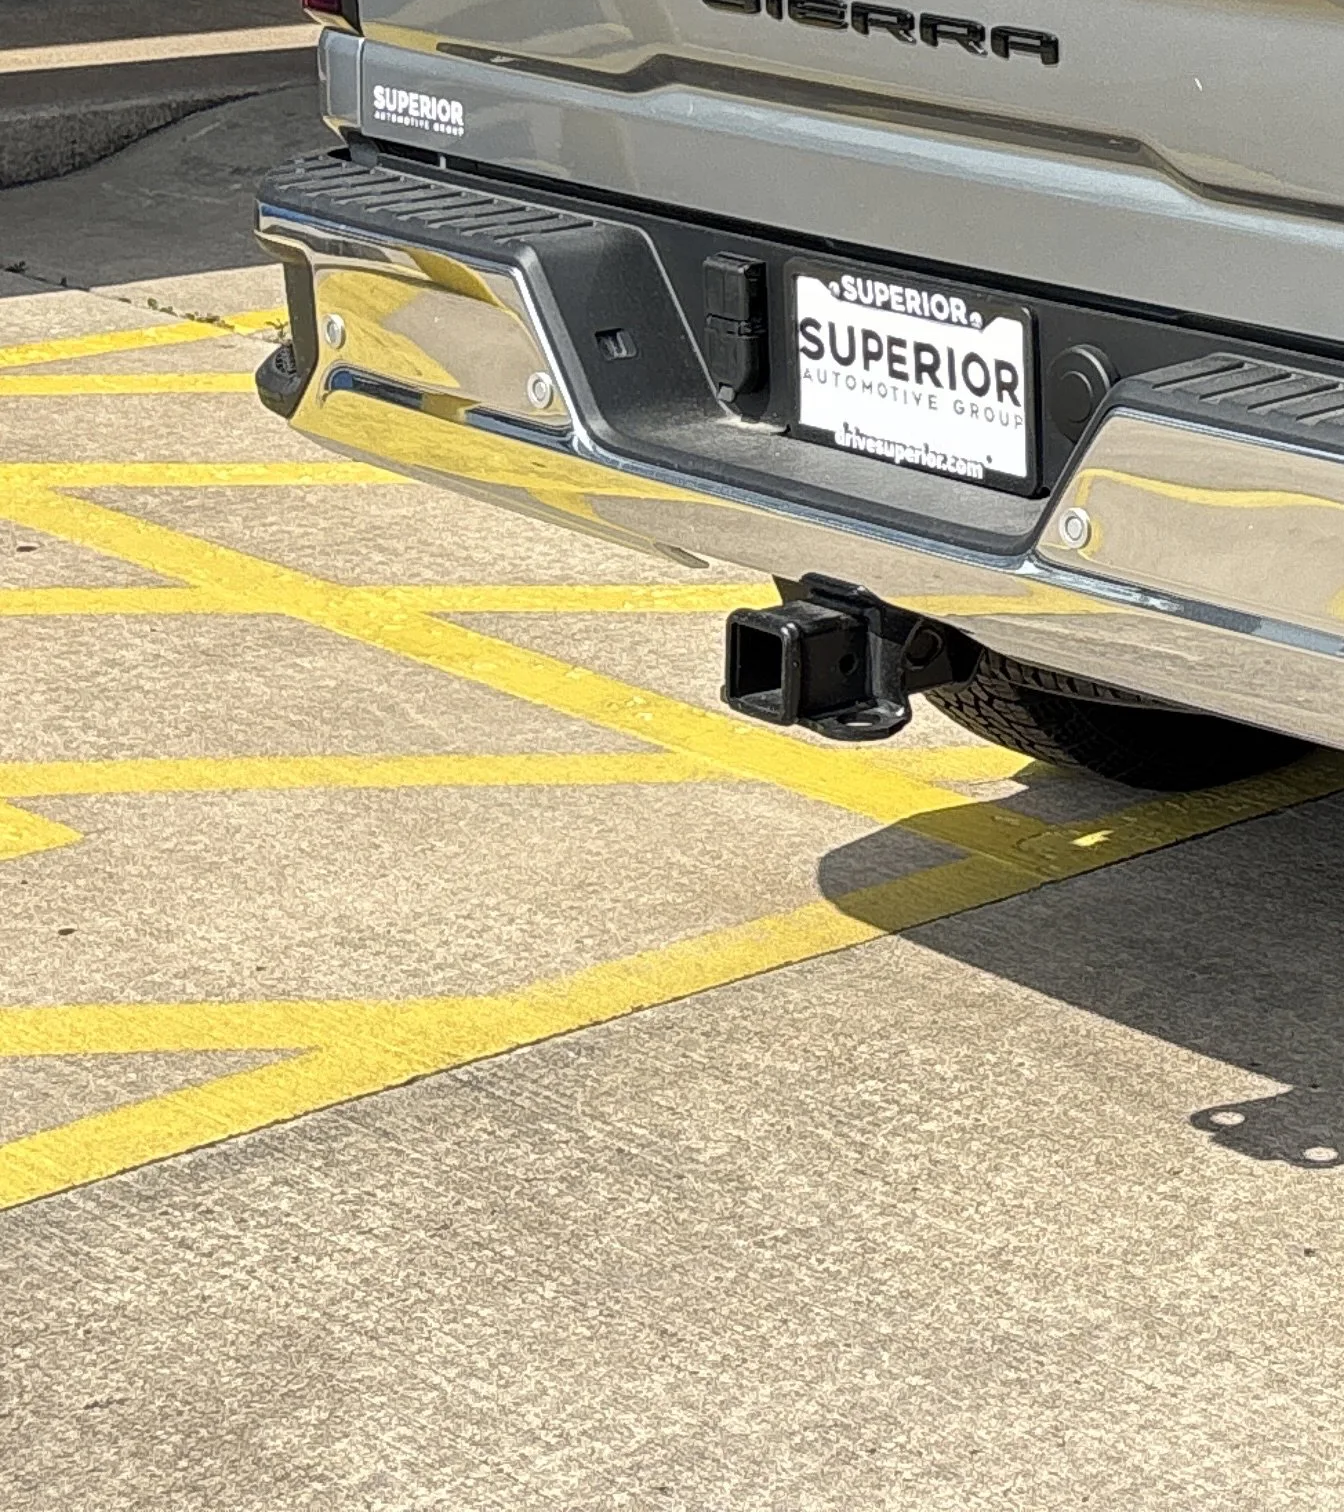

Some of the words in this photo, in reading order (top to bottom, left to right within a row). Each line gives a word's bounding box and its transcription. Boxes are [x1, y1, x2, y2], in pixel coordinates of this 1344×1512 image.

[373, 85, 465, 127] SUPERIOR
[840, 275, 968, 325] SUPERIOR
[799, 317, 1022, 407] SUPERIOR
[803, 367, 940, 411] AUTOMOTIVE
[953, 399, 1024, 430] GROUP
[834, 422, 985, 480] drivesuperior.com
